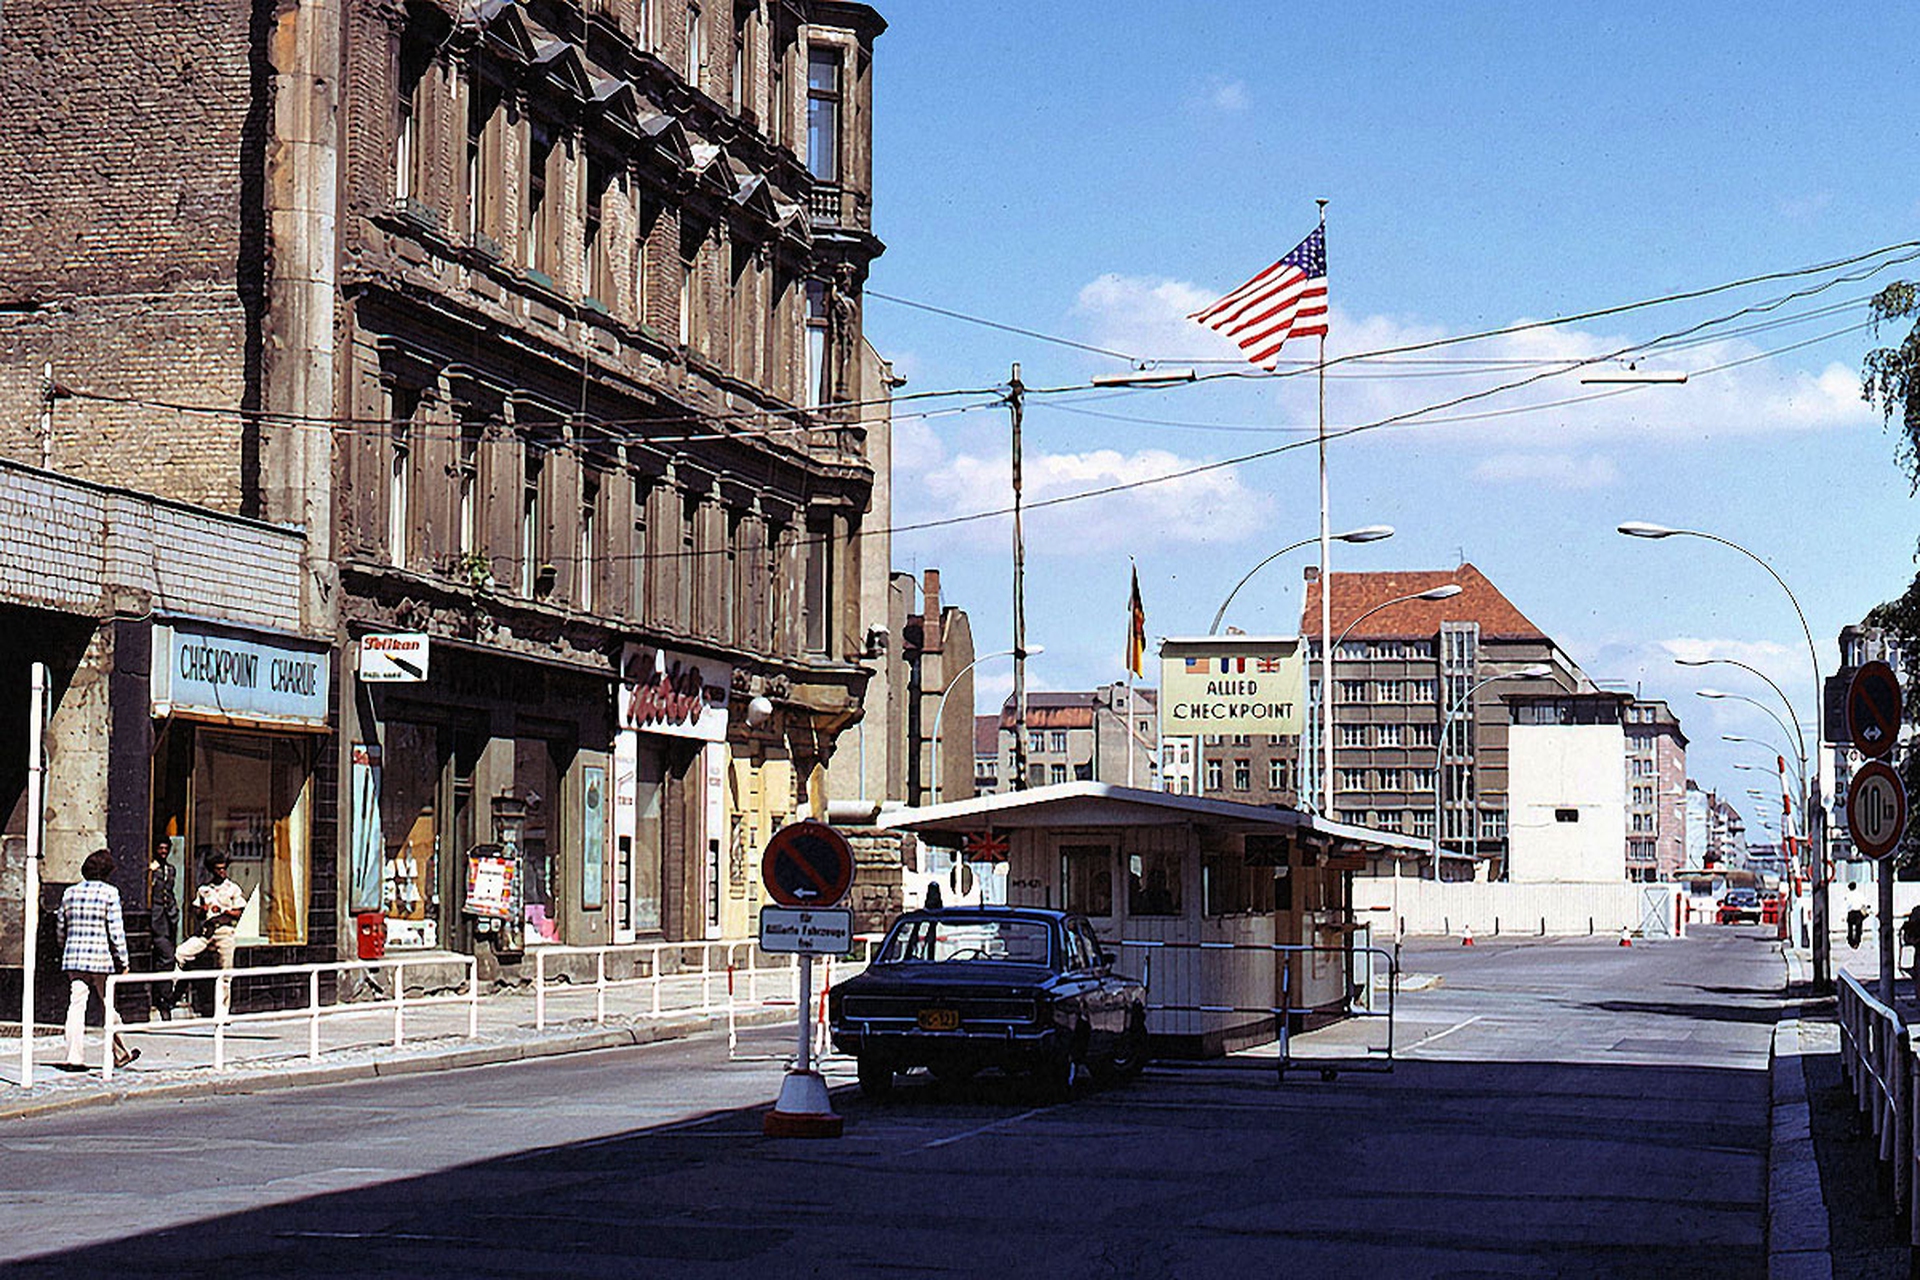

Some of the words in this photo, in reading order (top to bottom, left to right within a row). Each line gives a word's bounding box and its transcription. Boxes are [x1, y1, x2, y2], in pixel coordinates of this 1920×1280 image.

[364, 636, 420, 650] Pelikan
[180, 644, 259, 689] CHECKPOINT
[270, 658, 318, 696] CHARLIE
[1206, 680, 1257, 695] ALLIED
[1173, 703, 1293, 719] CHECKPOINT
[1860, 786, 1881, 836] 10
